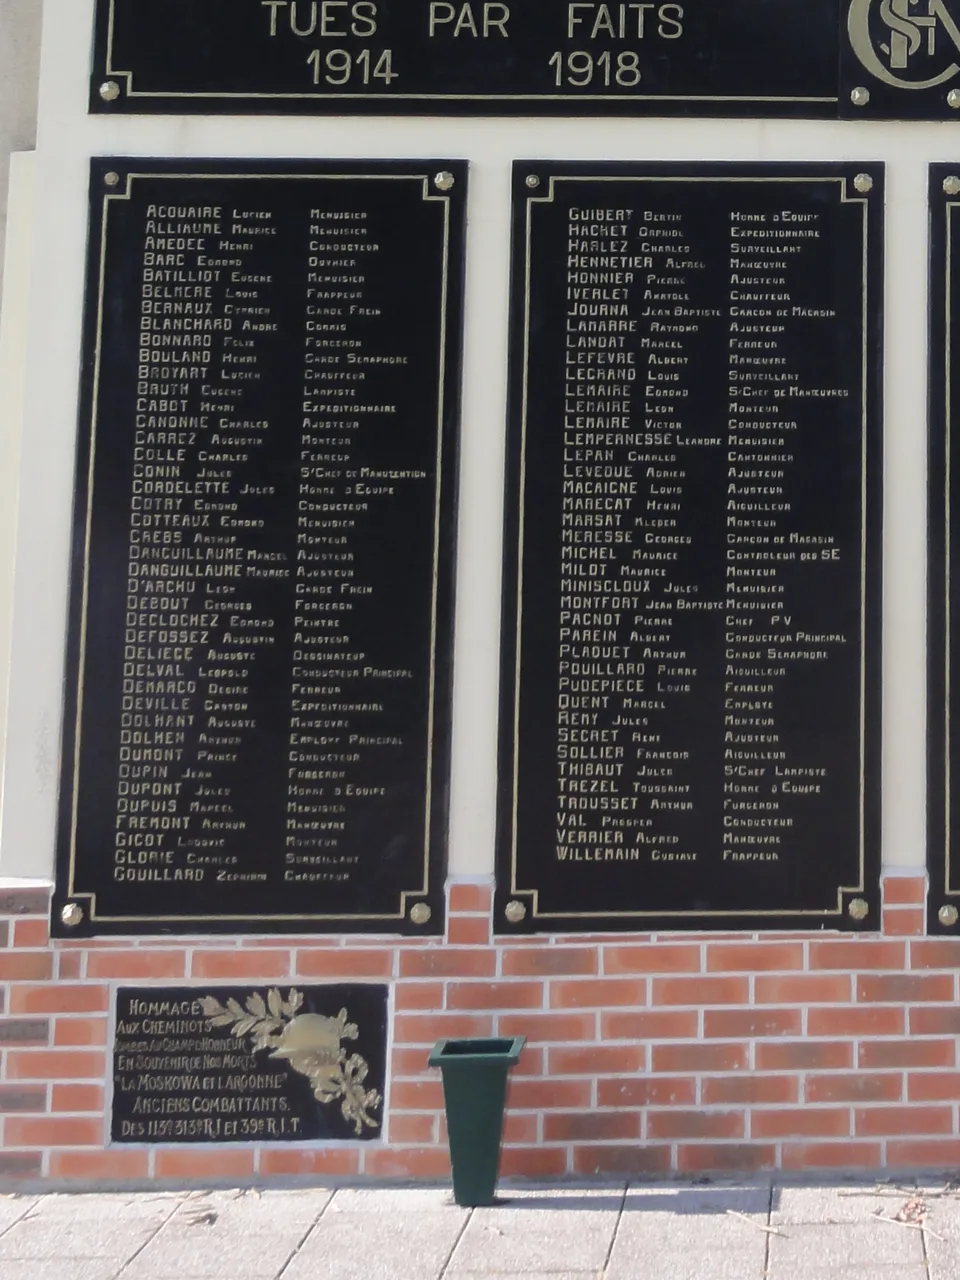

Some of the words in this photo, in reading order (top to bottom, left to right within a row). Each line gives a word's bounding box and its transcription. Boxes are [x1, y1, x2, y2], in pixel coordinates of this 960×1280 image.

[262, 1, 377, 36] TUES
[430, 2, 509, 37] PAR
[568, 3, 683, 38] FAITS
[307, 49, 398, 84] 1914
[549, 51, 641, 86] 1918
[557, 812, 586, 826] VAL
[130, 999, 200, 1016] HOMMAGE
[142, 1019, 212, 1033] CHEMINOTS
[138, 1074, 201, 1091] MOSKOWA
[132, 1097, 190, 1114] ANCIENS
[122, 1120, 144, 1136] DES
